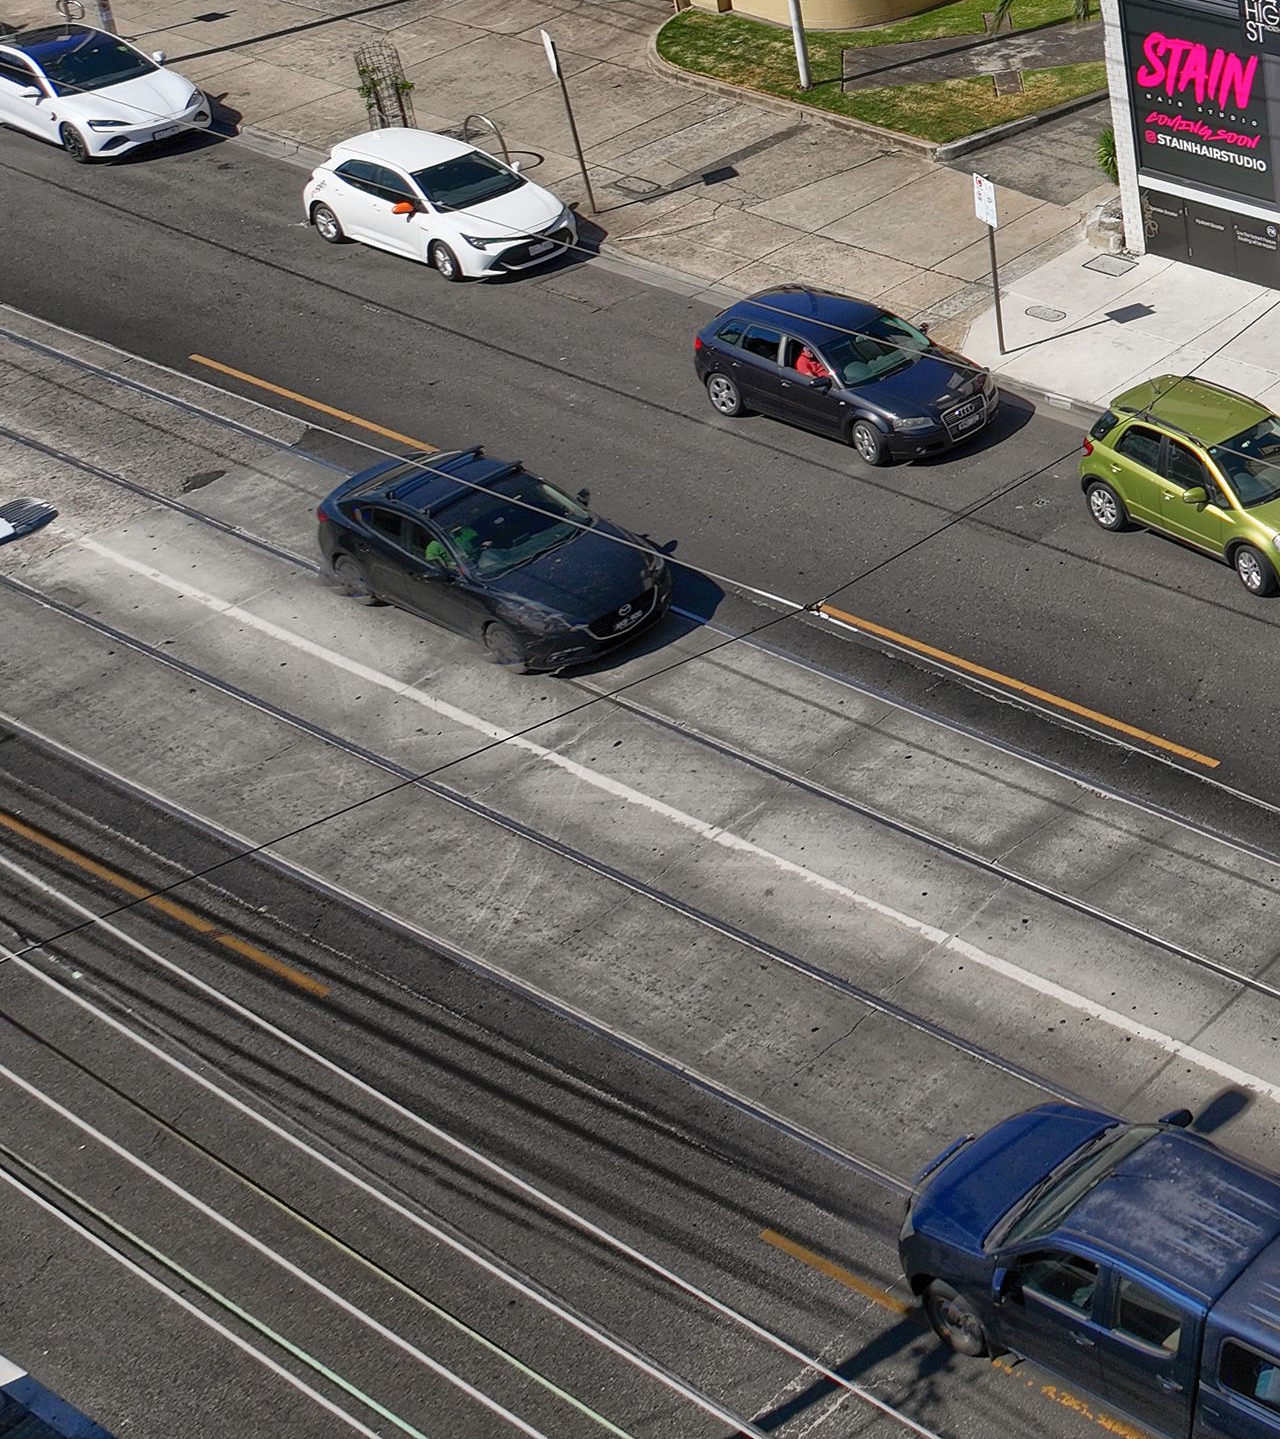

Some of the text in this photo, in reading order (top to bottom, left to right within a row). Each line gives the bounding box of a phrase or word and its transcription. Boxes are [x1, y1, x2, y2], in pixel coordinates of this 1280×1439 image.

[1246, 20, 1265, 43] ST
[1136, 31, 1259, 110] STAIN
[1146, 93, 1258, 127] HAIR STUDIO
[1145, 111, 1262, 149] COMING SOON
[1156, 133, 1268, 172] STAINHAIRSTUDIO
